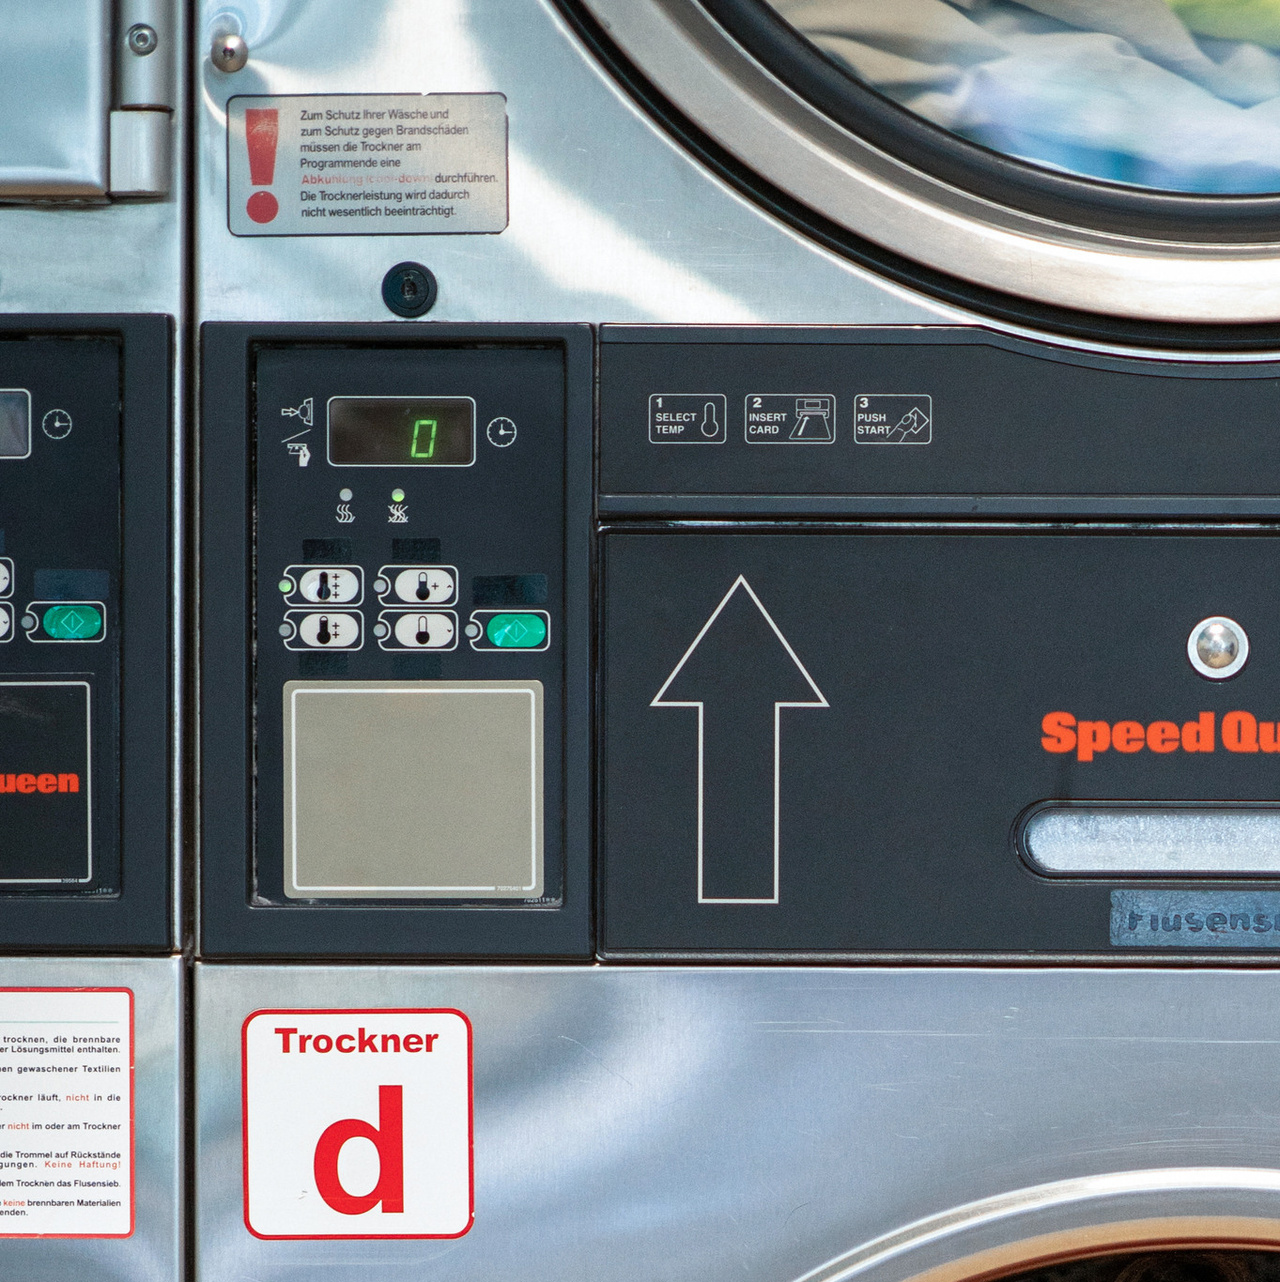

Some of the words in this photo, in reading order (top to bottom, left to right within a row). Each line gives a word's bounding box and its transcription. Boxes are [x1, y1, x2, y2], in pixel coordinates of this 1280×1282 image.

[300, 110, 323, 120] Zum
[326, 110, 361, 120] Schutz
[363, 110, 386, 120] Ihrer
[388, 109, 428, 120] Wäsche
[430, 109, 449, 119] und
[301, 128, 322, 136] zum
[325, 126, 360, 136] Schutz
[362, 128, 393, 138] gegen
[396, 124, 469, 135] Brandschäden
[300, 142, 340, 152] müssen
[343, 142, 358, 152] die
[360, 141, 404, 152] Trockner
[406, 143, 422, 151] am
[300, 158, 378, 171] Programmende
[380, 158, 401, 167] eine
[435, 173, 498, 183] durchführen.
[300, 191, 316, 201] Die
[319, 190, 402, 202] Trocknerleistung
[405, 190, 426, 200] wird
[428, 189, 470, 200] dadurch
[301, 207, 326, 217] nicht
[328, 206, 382, 216] wesentlich
[384, 206, 456, 218] beeinträchtigt.
[656, 398, 663, 408] 1
[753, 398, 762, 408] 2
[859, 398, 869, 408] 3
[655, 413, 697, 422] SELECT
[749, 413, 787, 422] INSERT
[857, 413, 886, 422] PUSH
[655, 425, 685, 434] TEMP
[749, 425, 780, 434] CARD
[857, 425, 891, 435] START
[411, 420, 437, 458] 0
[1041, 711, 1215, 762] Speed
[0, 773, 79, 793] ueen
[3, 1036, 48, 1044] trocknen,
[53, 1036, 67, 1044] die
[73, 1036, 120, 1044] brennbare
[275, 1028, 439, 1053] Trockner
[11, 1046, 74, 1054] Lösungsmittel
[77, 1046, 120, 1054] enthalten.
[17, 1066, 78, 1074] gewaschener
[82, 1065, 120, 1073] Textilien
[38, 1094, 61, 1102] läuft,
[66, 1094, 89, 1102] nicht
[94, 1094, 102, 1102] in
[107, 1094, 121, 1102] die
[0, 1151, 13, 1159] die
[15, 1151, 52, 1159] Trommel
[55, 1151, 68, 1159] auf
[71, 1151, 121, 1159] Rückstände
[314, 1085, 404, 1215] d
[16, 1180, 54, 1188] Trocknen
[57, 1180, 72, 1188] das
[74, 1180, 120, 1188] Flusensieb.
